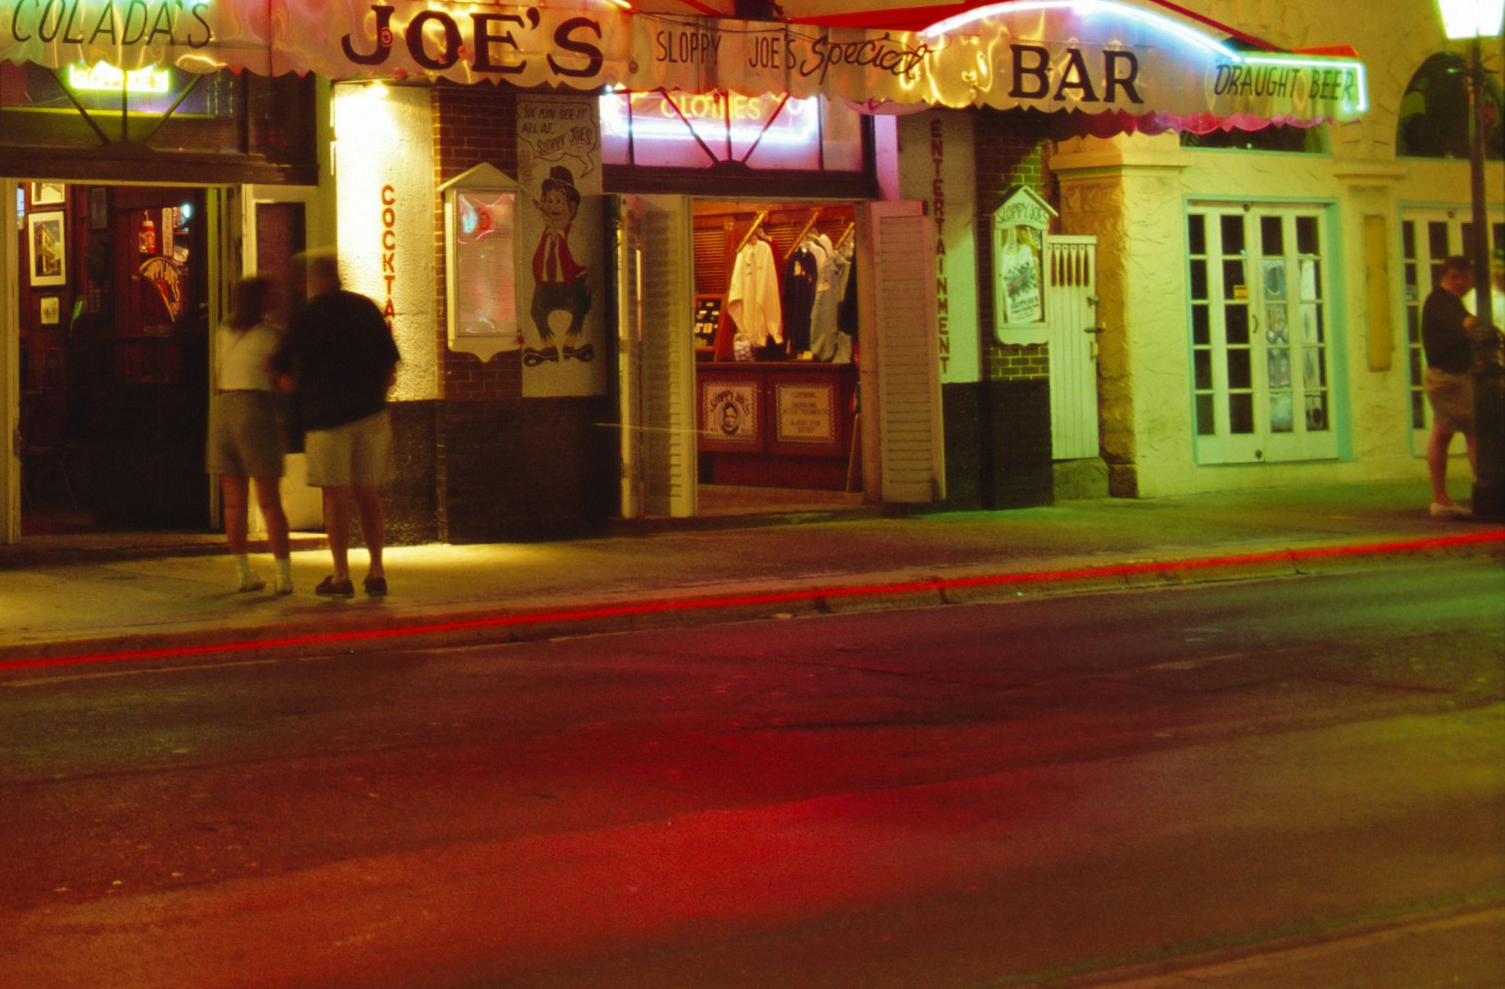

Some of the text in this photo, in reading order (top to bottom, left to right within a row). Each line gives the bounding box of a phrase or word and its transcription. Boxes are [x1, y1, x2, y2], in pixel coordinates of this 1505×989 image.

[341, 5, 603, 78] JOE'S
[1008, 44, 1144, 104] BAR
[656, 30, 928, 86] SLOPPY JOE'S Special
[1213, 62, 1357, 102] DRAUGHT BEER
[997, 202, 1030, 224] SLOPPY
[929, 119, 951, 374] ENTERTAINMENT
